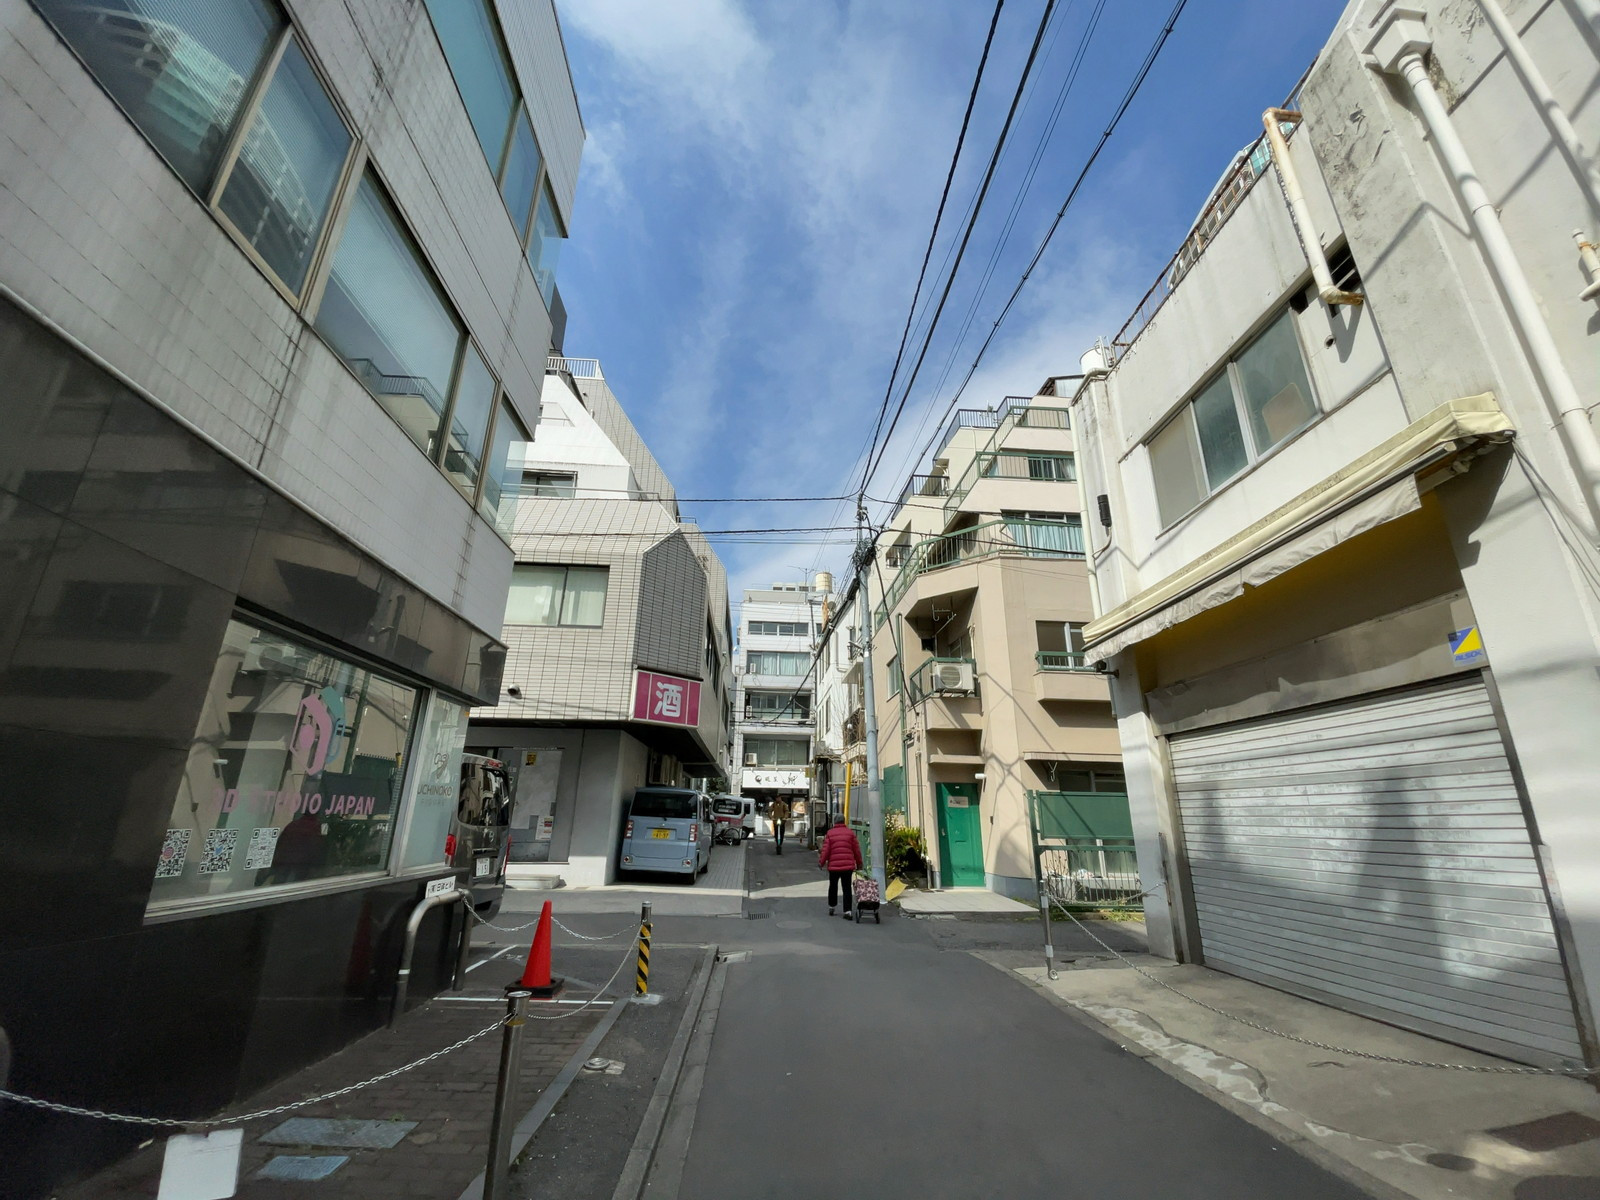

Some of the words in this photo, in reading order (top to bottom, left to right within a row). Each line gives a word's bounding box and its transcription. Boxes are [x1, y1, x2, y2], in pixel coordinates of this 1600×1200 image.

[653, 681, 683, 718] 酒
[417, 784, 453, 797] UCHINOKO
[324, 794, 377, 815] JAPAN
